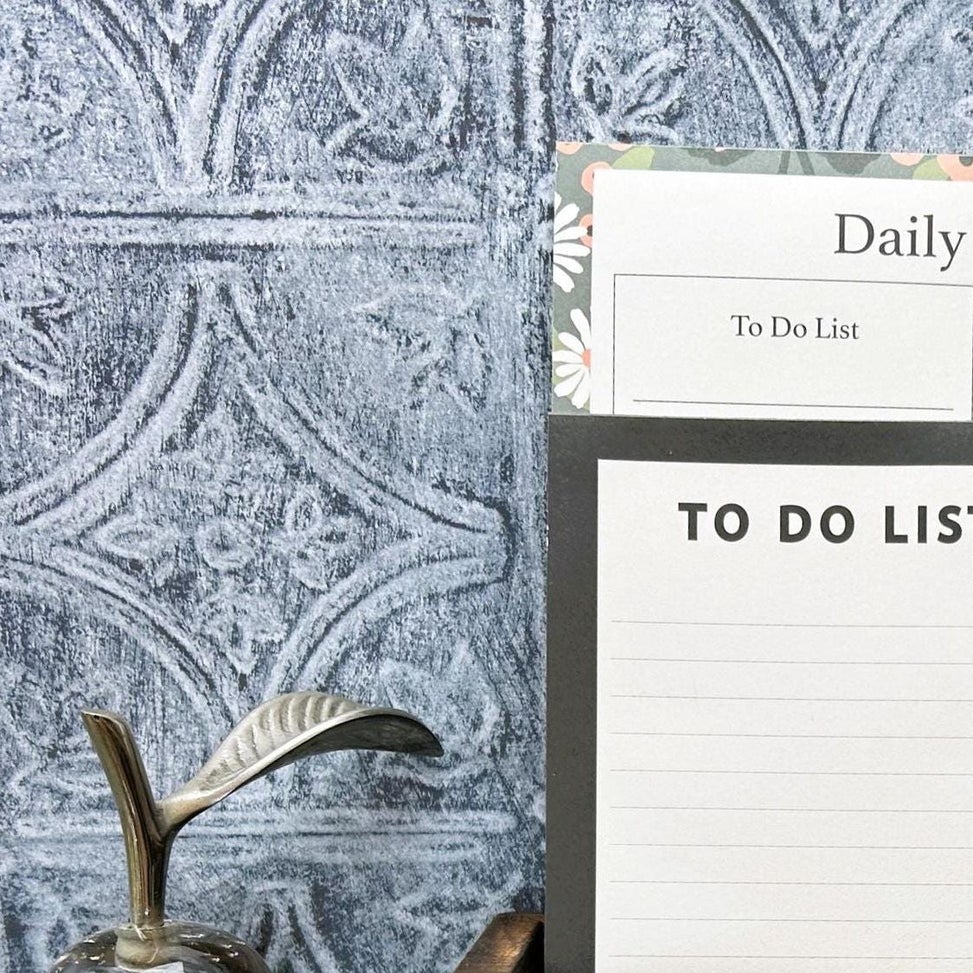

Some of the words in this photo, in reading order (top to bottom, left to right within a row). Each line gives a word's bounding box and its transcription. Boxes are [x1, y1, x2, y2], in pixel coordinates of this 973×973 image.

[833, 213, 967, 272] Daily
[729, 315, 763, 338] To
[771, 316, 807, 339] Do
[816, 316, 859, 341] List
[677, 502, 750, 543] TO
[779, 504, 855, 544] DO
